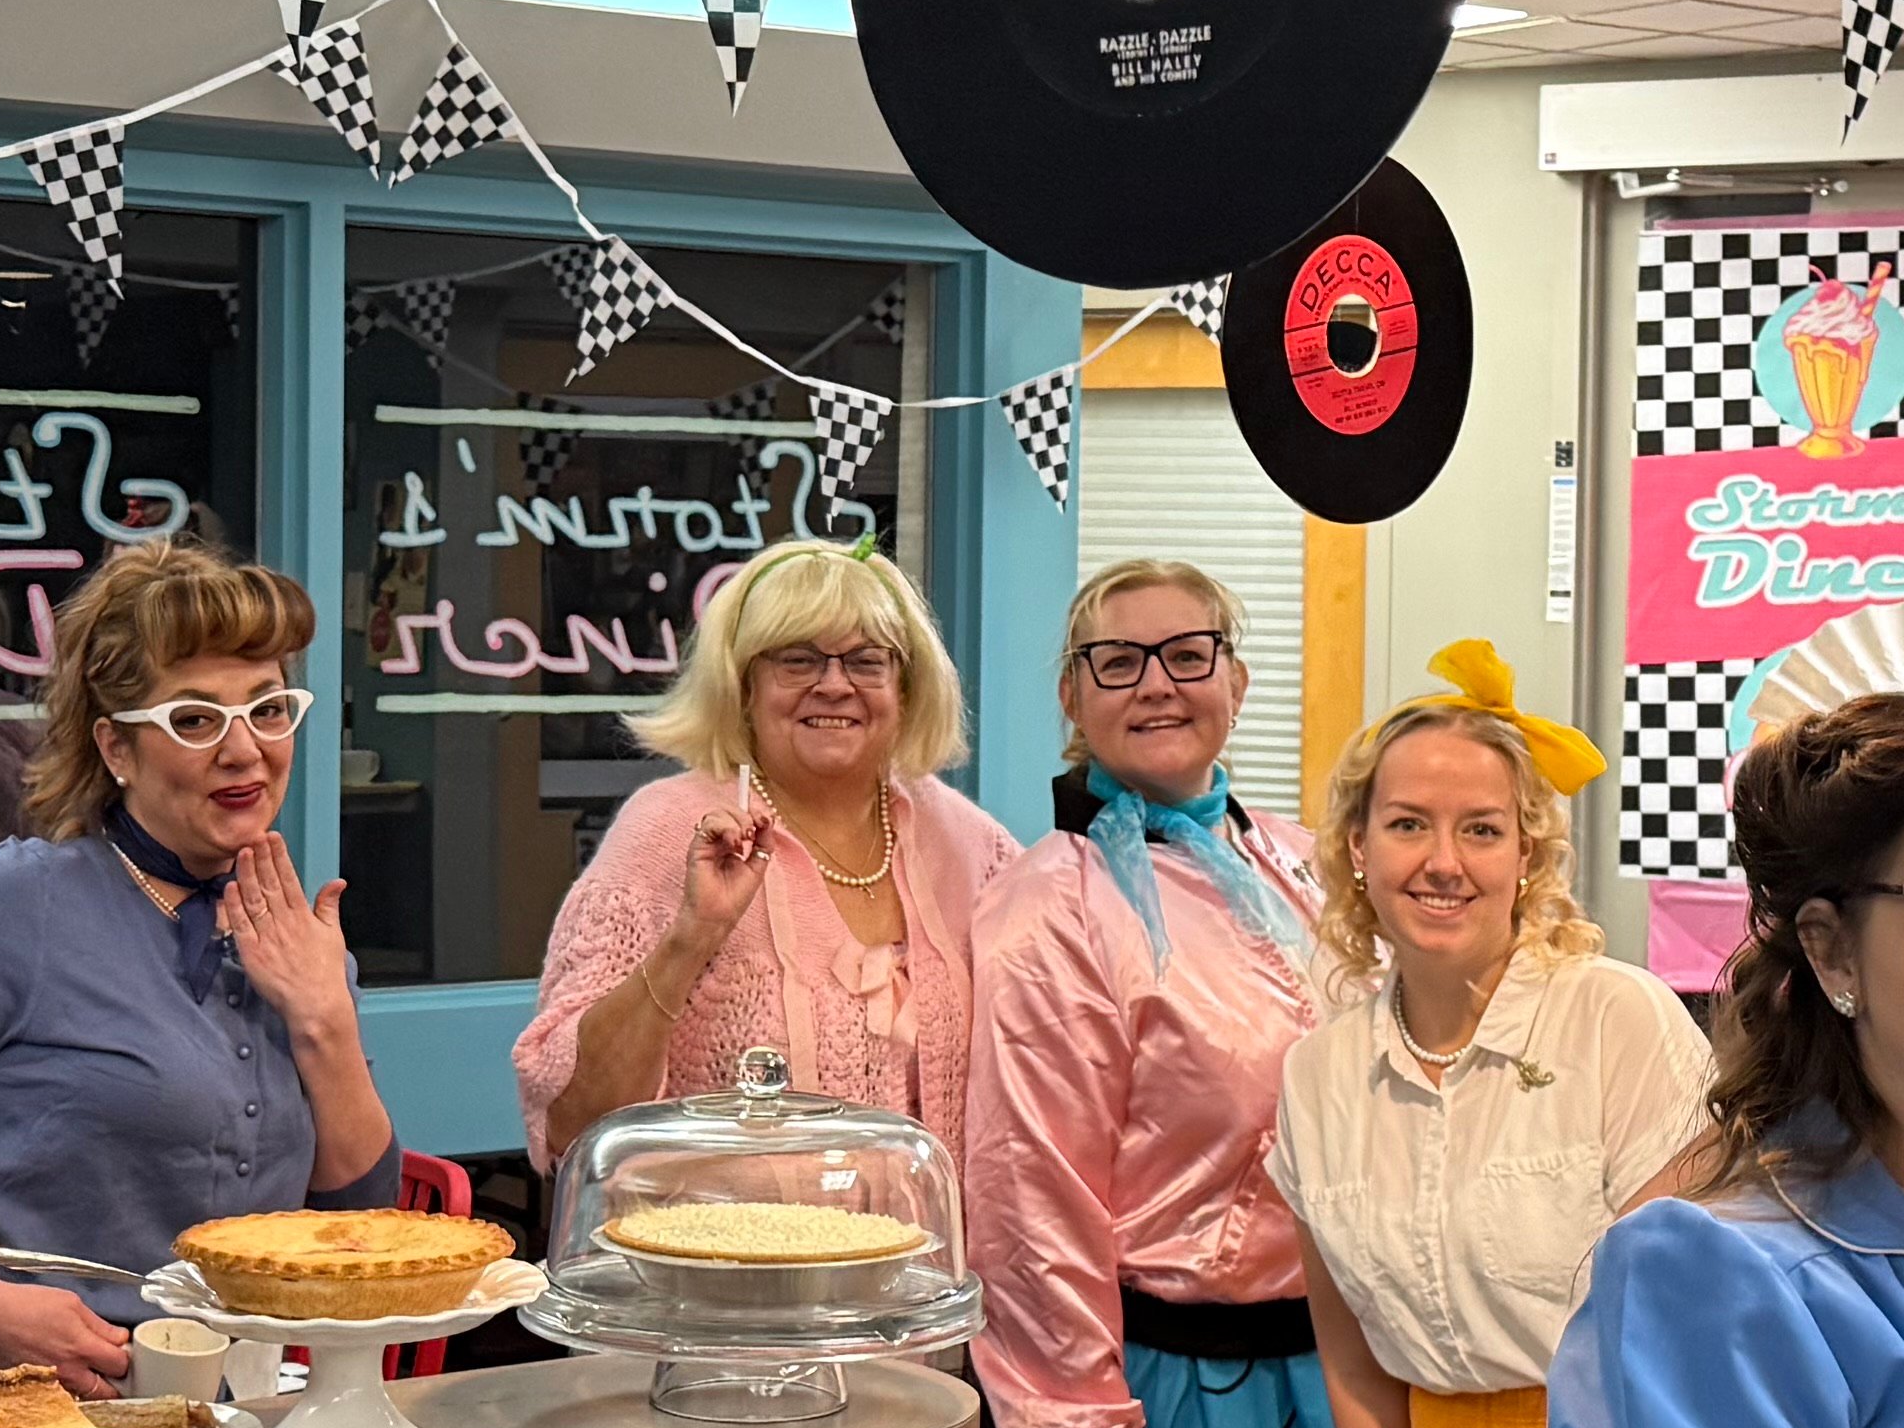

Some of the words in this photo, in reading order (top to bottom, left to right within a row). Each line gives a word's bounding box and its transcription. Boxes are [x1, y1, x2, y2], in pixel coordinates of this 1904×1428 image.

[1100, 32, 1149, 54] RAZZLE
[1159, 24, 1211, 46] DAZZLE
[1151, 54, 1202, 73] HALEY
[1299, 249, 1392, 313] DECCA
